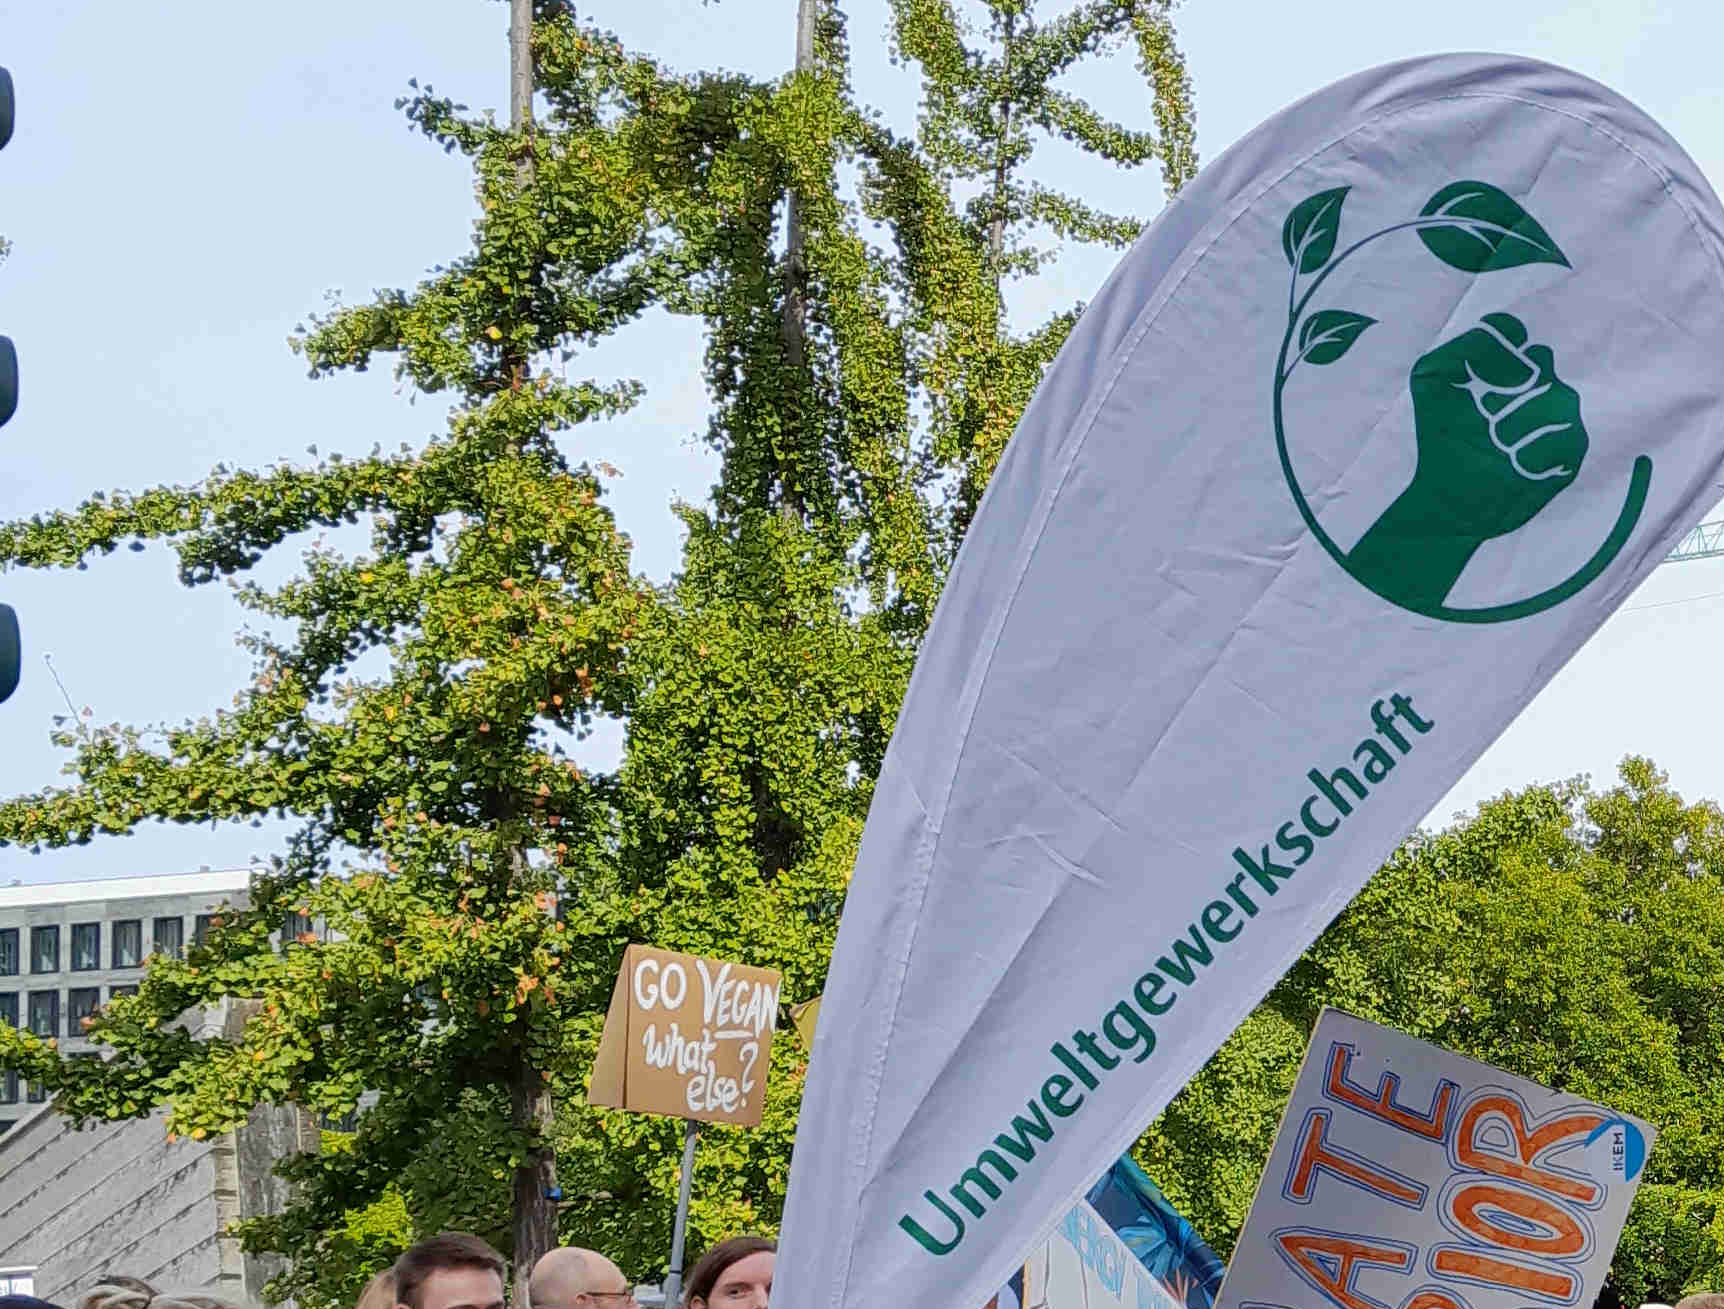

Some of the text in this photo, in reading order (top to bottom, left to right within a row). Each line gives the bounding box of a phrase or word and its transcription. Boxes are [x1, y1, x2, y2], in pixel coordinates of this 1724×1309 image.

[634, 958, 783, 1038] GO VEGAN
[898, 691, 1436, 1257] Umweltgewerkschaft
[1612, 1132, 1624, 1171] IKEM
